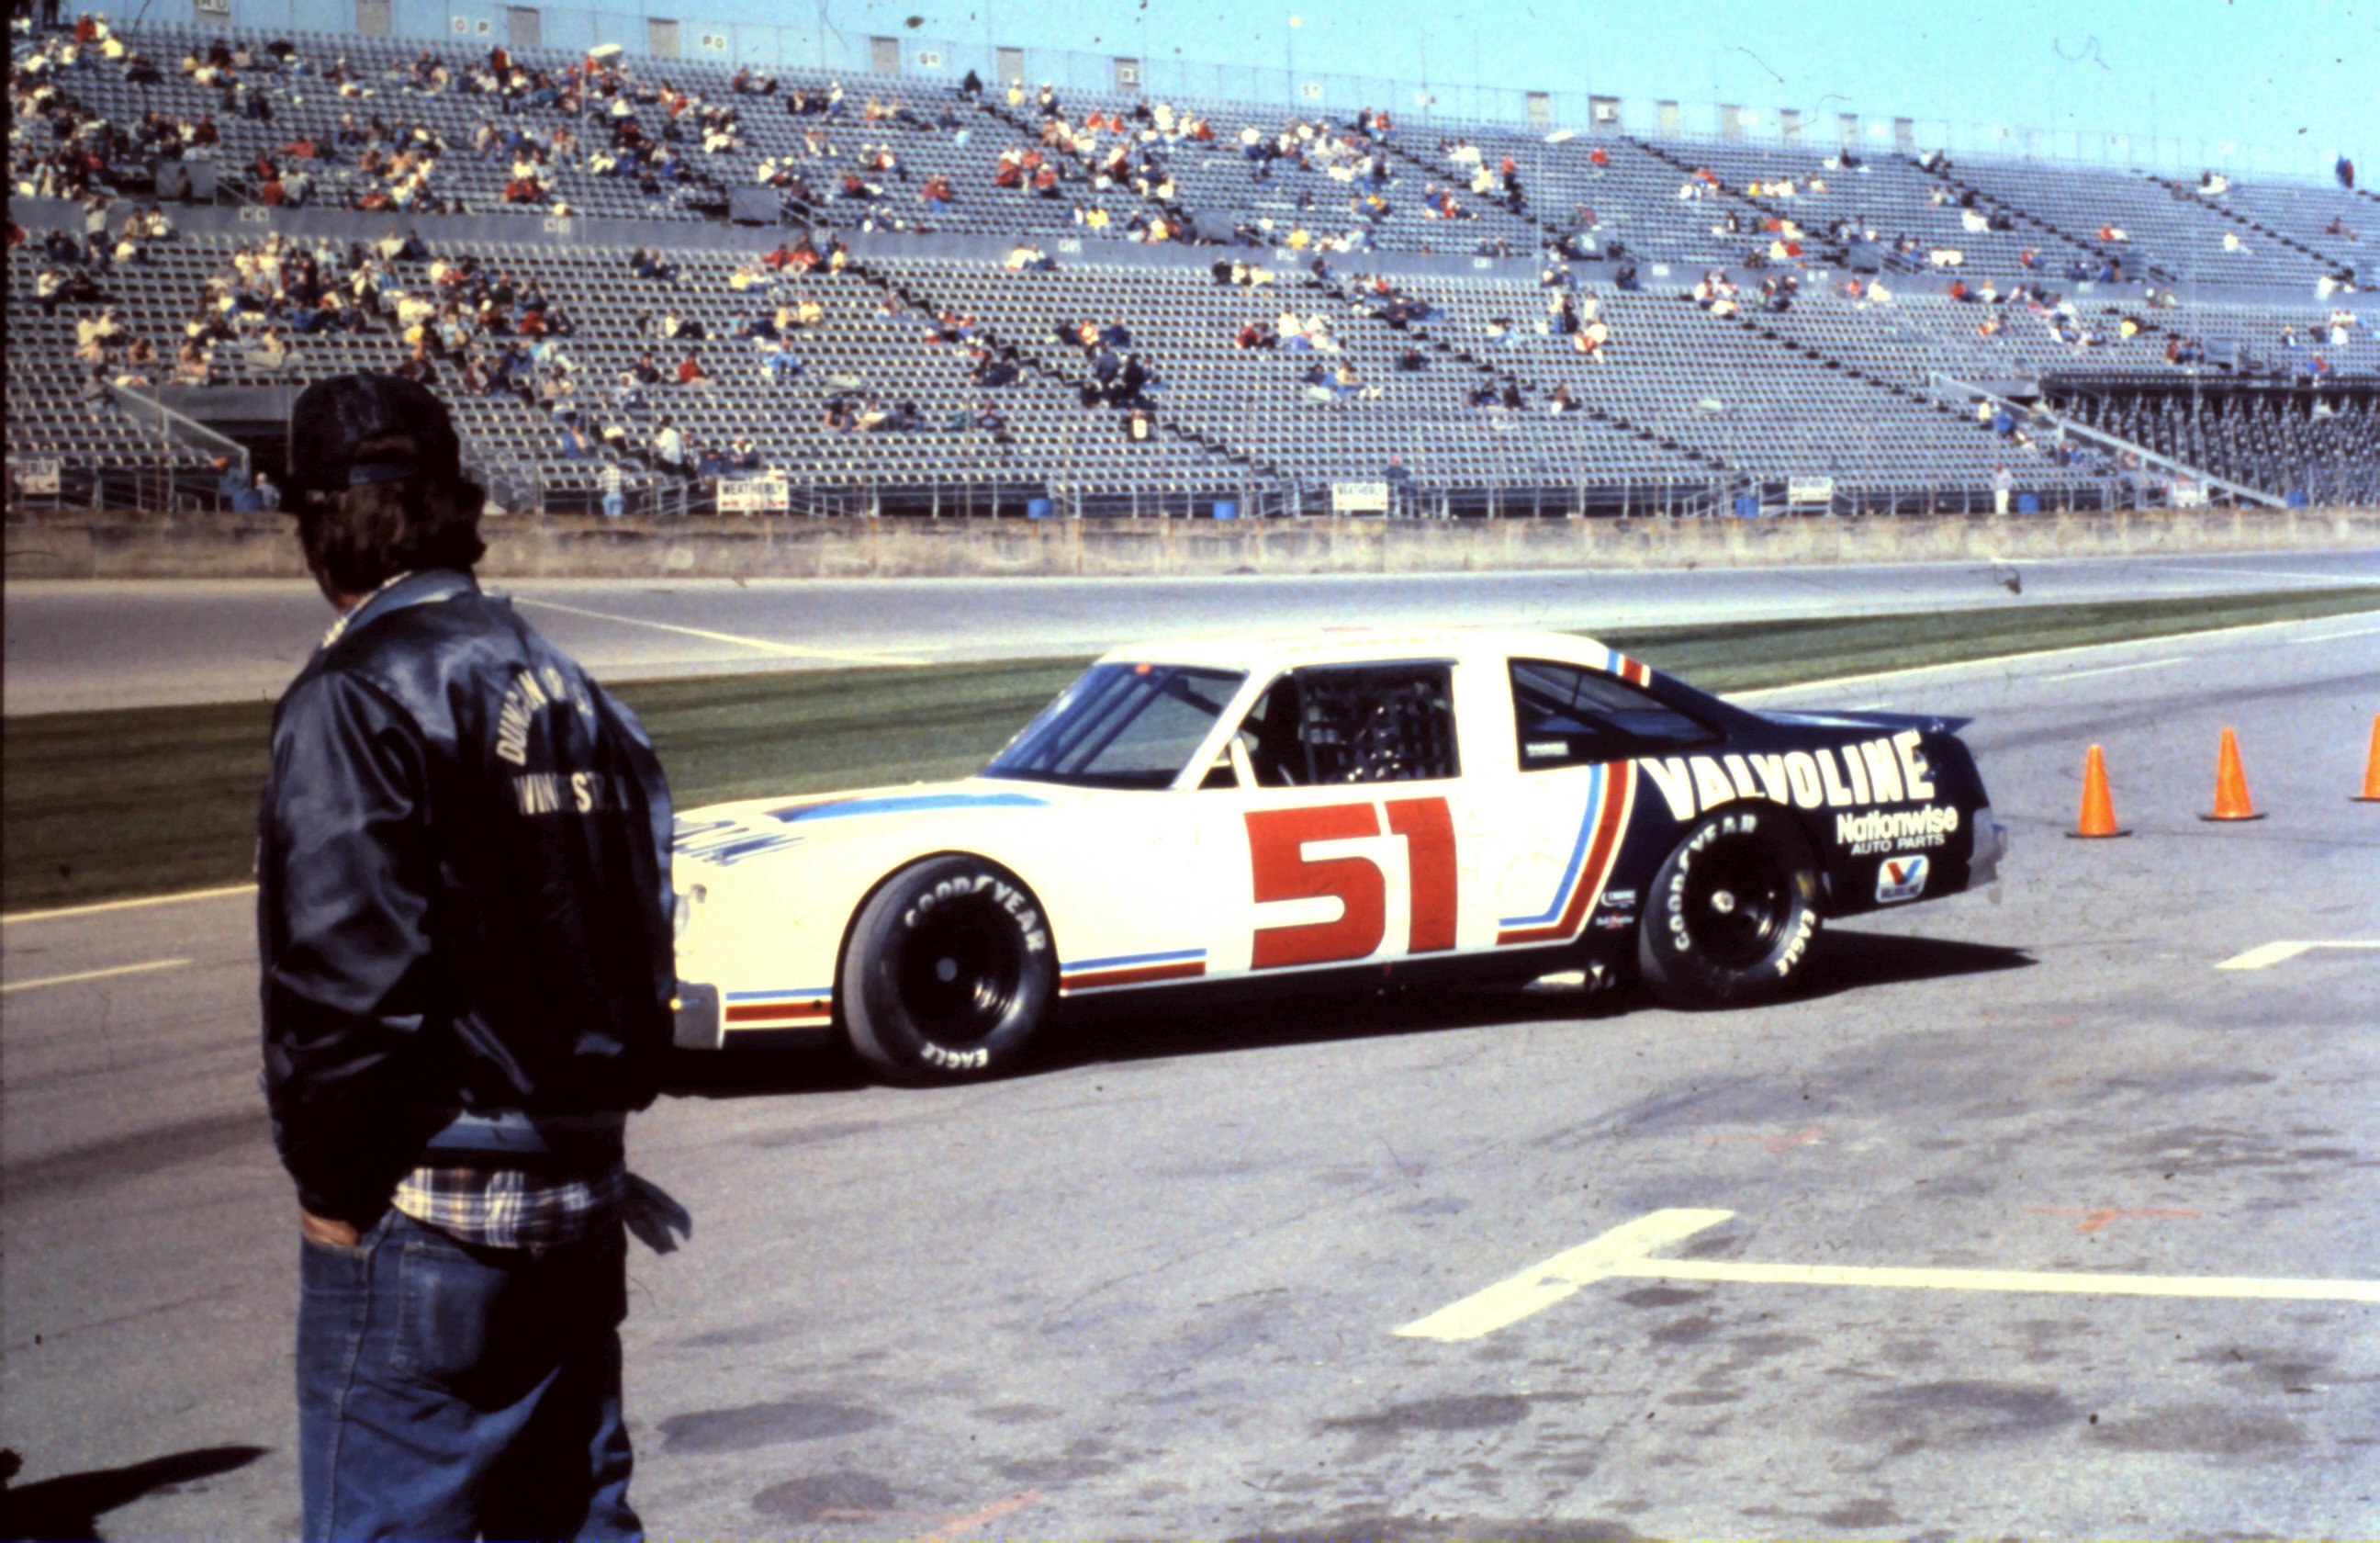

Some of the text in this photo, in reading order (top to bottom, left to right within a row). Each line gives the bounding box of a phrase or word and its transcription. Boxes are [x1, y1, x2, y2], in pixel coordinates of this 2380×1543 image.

[1638, 727, 1936, 822] VALVOLINE
[1836, 804, 1959, 846] Nationwise
[1850, 833, 1947, 856] AUTO PARTS
[1243, 795, 1458, 972] 51
[1775, 908, 1816, 978] EAGLE
[921, 1040, 989, 1069] EAGLE
